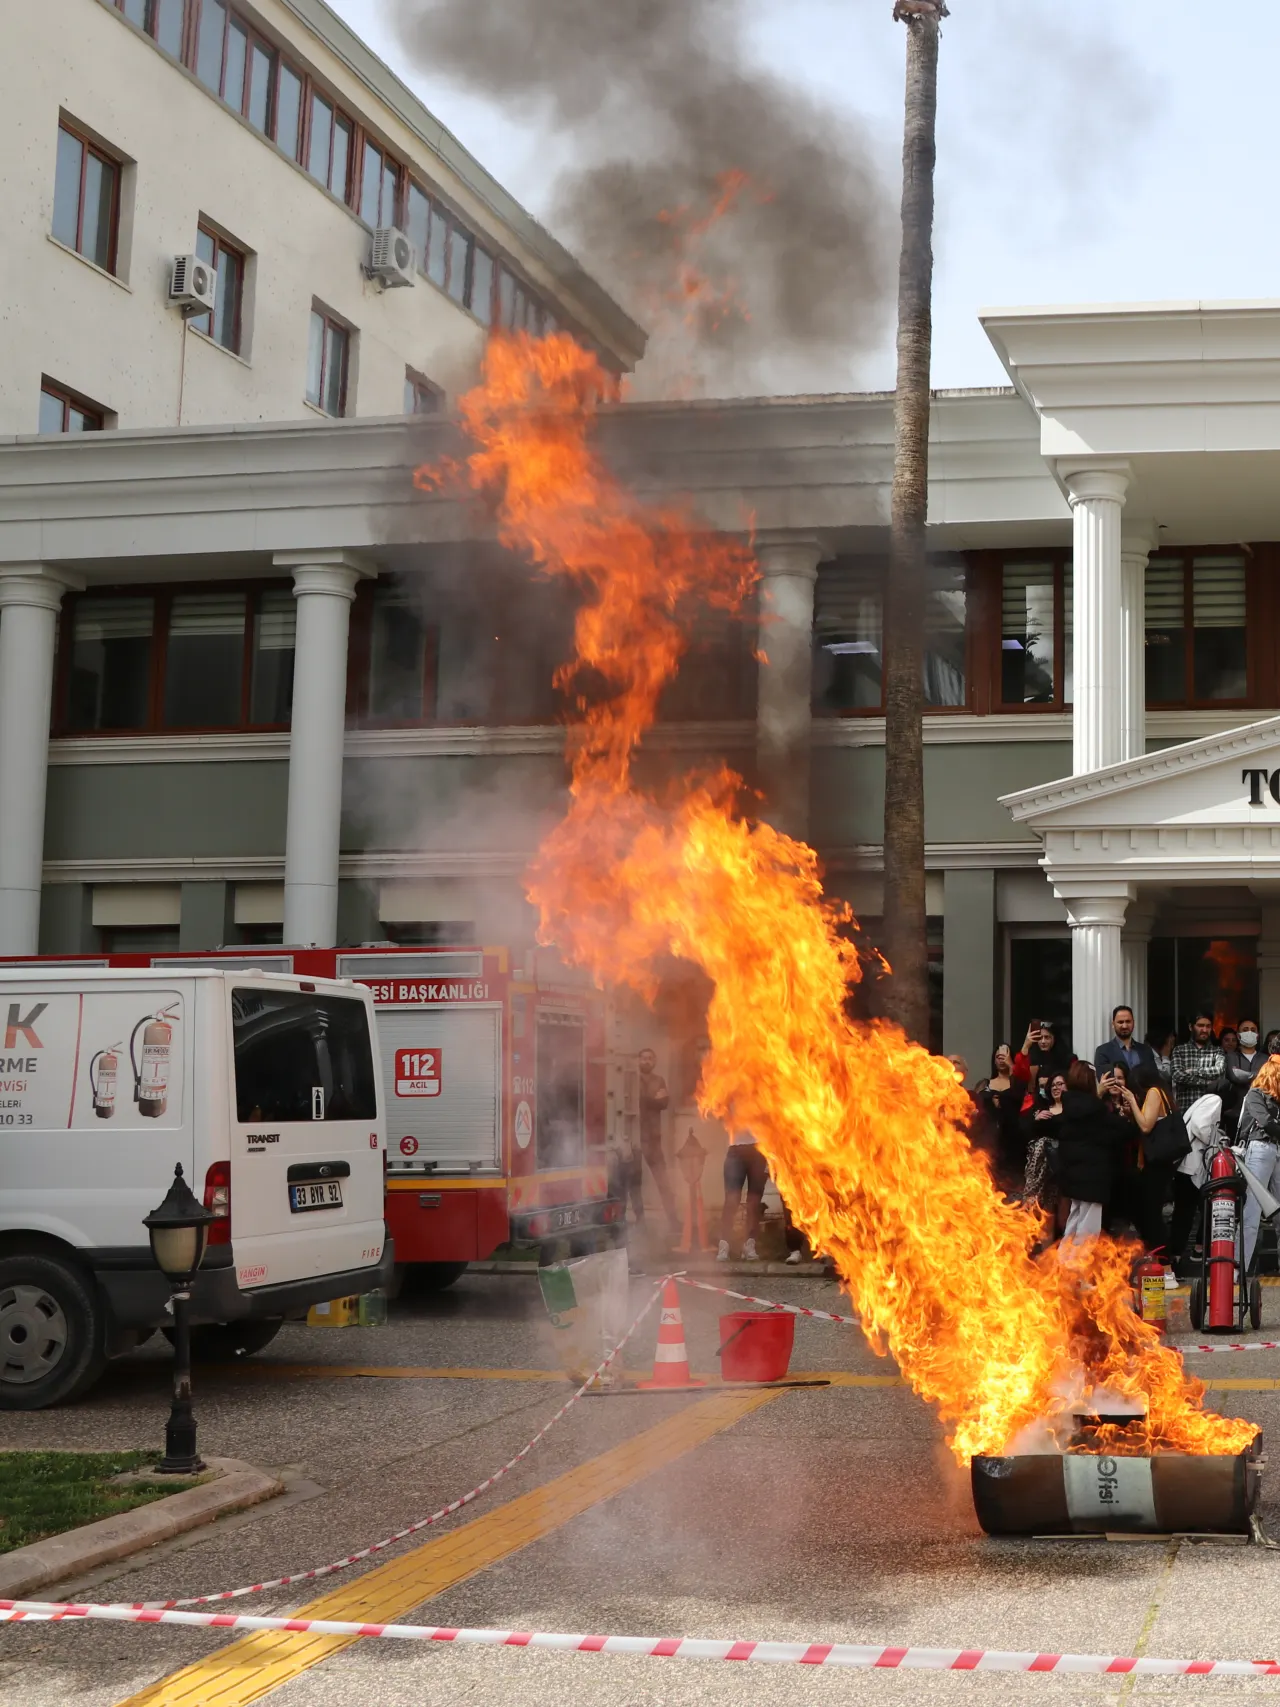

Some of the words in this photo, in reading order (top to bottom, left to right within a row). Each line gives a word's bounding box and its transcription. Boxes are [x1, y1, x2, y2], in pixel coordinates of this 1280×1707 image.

[399, 981, 489, 1004] BAŞKANLIĞI
[5, 1003, 49, 1048] K
[401, 1054, 435, 1077] 112
[17, 1114, 33, 1125] 33
[246, 1134, 280, 1144] TRANSIT
[403, 1139, 415, 1153] 3
[296, 1187, 306, 1205] 33
[310, 1186, 325, 1204] BYR
[328, 1185, 339, 1202] 92
[361, 1247, 381, 1259] FIRE
[239, 1267, 266, 1279] YANGIN
